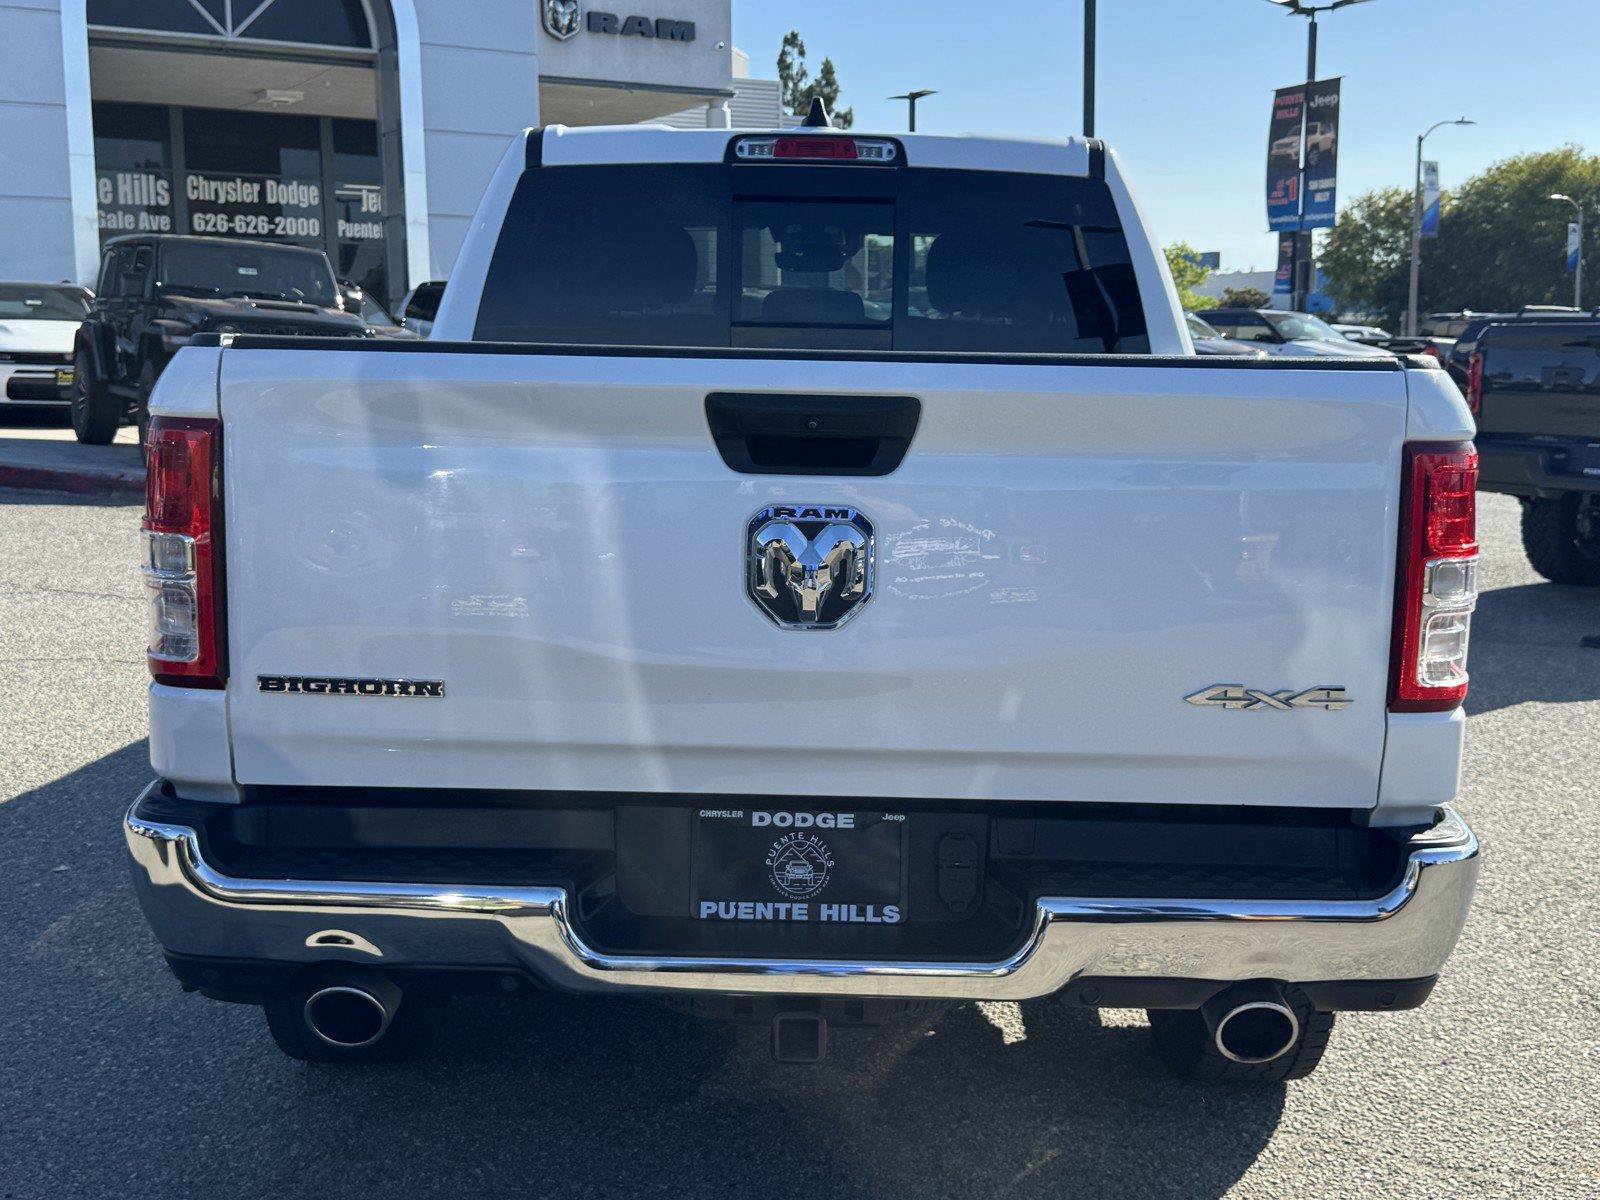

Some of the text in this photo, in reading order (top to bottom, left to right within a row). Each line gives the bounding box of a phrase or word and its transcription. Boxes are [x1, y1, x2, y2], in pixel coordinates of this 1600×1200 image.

[587, 11, 696, 42] RAM
[1310, 94, 1338, 108] Jeep
[117, 173, 171, 206] Hills
[186, 175, 261, 204] Chrysler
[266, 180, 319, 208] Dodge
[139, 211, 171, 231] Ave
[193, 213, 320, 237] 626-626-2000
[773, 507, 849, 519] RAM
[258, 675, 445, 698] BIGHORN
[700, 809, 744, 818] CHRYSLER
[752, 811, 855, 828] DODGE
[882, 813, 906, 822] Jeep
[766, 832, 835, 867] PUENTE HILLS
[700, 901, 901, 923] PUENTE HILLS
